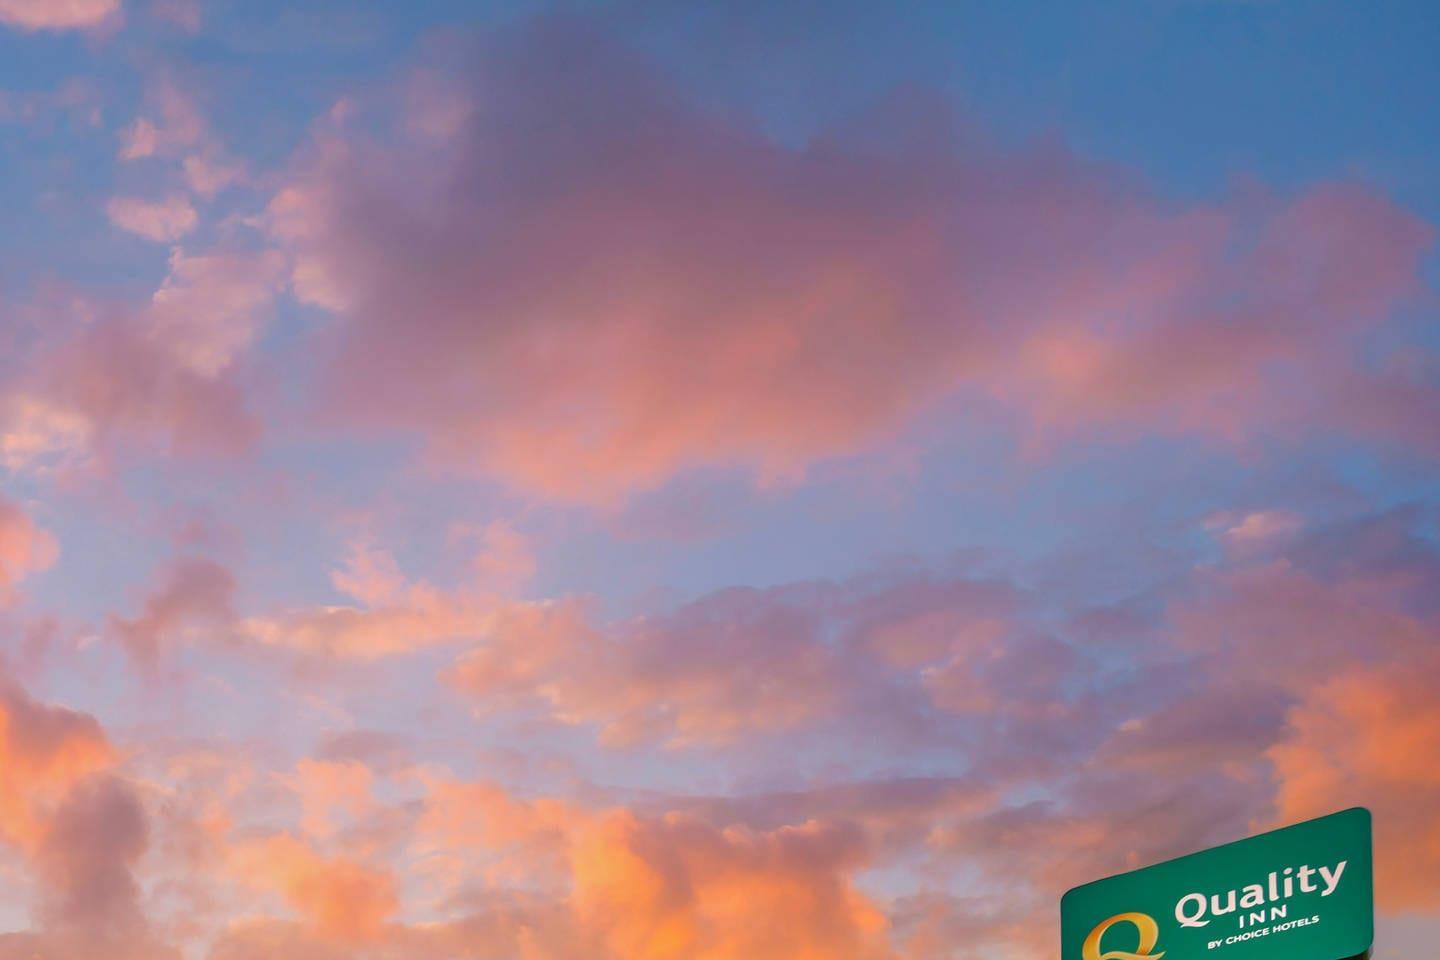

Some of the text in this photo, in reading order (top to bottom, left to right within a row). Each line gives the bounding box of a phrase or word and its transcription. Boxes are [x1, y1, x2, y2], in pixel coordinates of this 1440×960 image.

[1174, 860, 1348, 929] Quality
[1207, 914, 1320, 950] BY CHOICE HOTELS
[1239, 904, 1288, 929] INN
